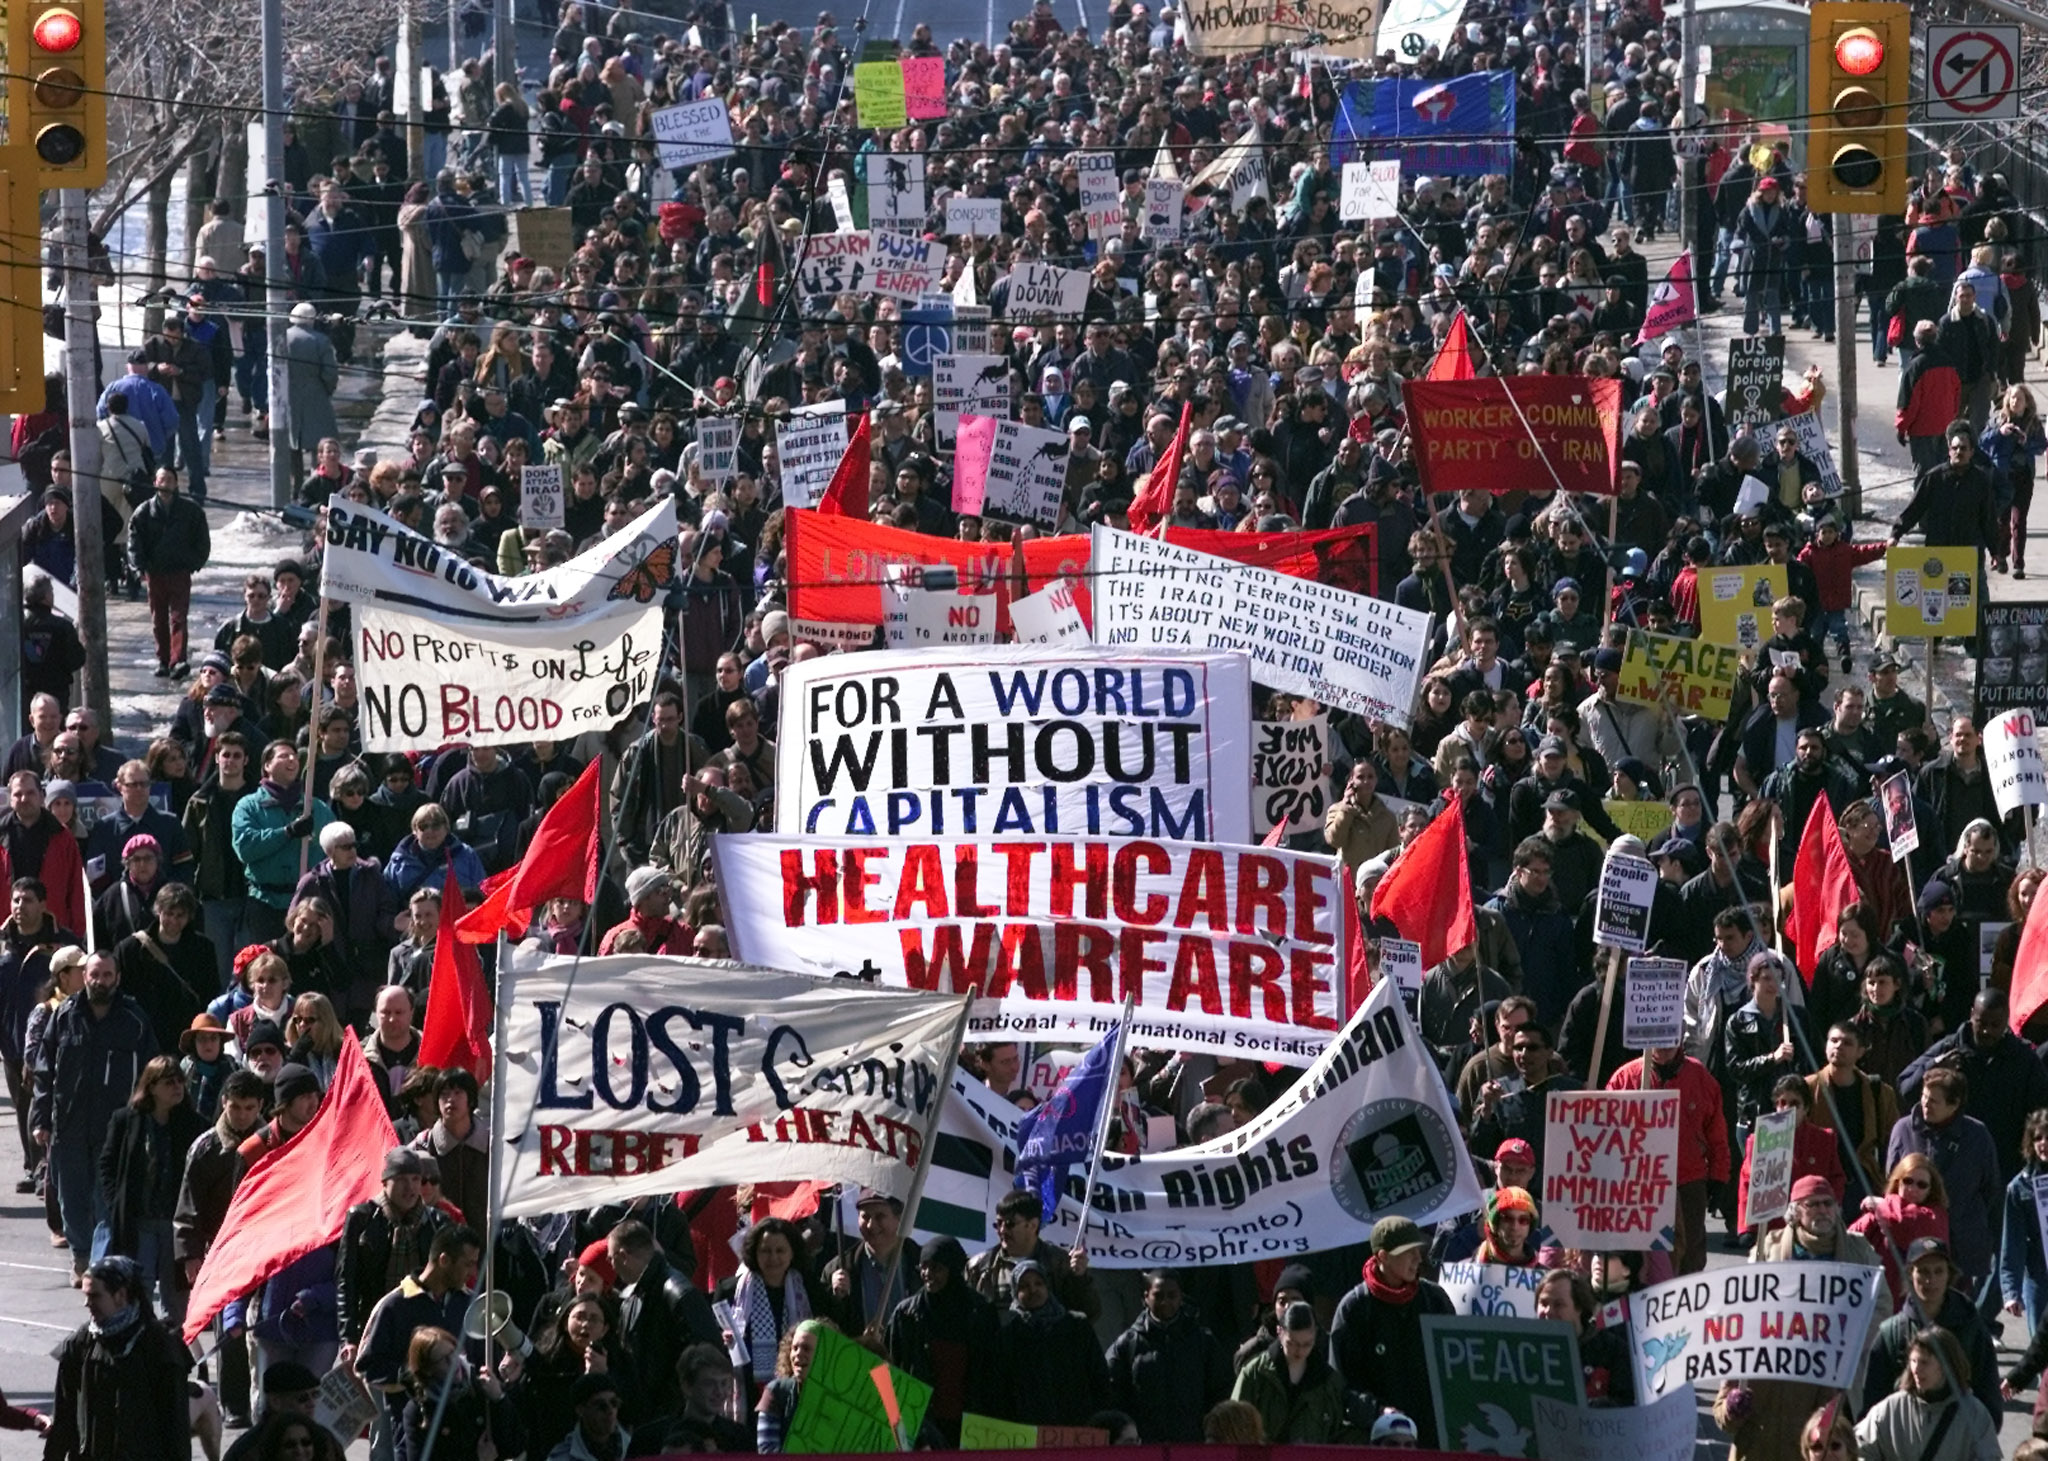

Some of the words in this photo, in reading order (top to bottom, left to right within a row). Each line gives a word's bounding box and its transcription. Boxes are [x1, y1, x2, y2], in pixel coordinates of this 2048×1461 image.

[1317, 3, 1372, 35] BOMB?
[654, 105, 721, 133] BLESSED
[1080, 155, 1115, 171] FOOD
[1088, 177, 1107, 186] NOT
[1231, 158, 1266, 191] YOUTH
[1351, 170, 1368, 183] NO
[1149, 182, 1183, 191] BOOKS
[1081, 190, 1117, 206] BOMBS
[948, 207, 1000, 227] CONSUME
[1150, 204, 1169, 213] NOT
[1345, 201, 1367, 218] OIL
[877, 233, 931, 264] BUSH
[817, 256, 846, 268] THE
[871, 258, 884, 267] IS
[887, 260, 908, 270] THE
[875, 269, 933, 296] ENEMY
[1028, 266, 1068, 290] LAY
[1016, 285, 1064, 306] DOWN
[937, 359, 956, 369] THIS
[1731, 352, 1780, 371] foreign
[937, 374, 945, 383] IS
[947, 374, 953, 383] A
[996, 385, 1008, 394] NO
[1423, 406, 1514, 429] WORKER
[702, 432, 714, 449] NO
[715, 429, 734, 448] WAR
[1000, 424, 1019, 437] THIS
[785, 434, 820, 450] DELAYED
[821, 434, 833, 446] BY
[833, 432, 841, 443] A
[995, 439, 1005, 450] IS
[1006, 440, 1013, 451] A
[1428, 439, 1502, 460] PARTY
[1518, 439, 1547, 459] OF
[1562, 438, 1604, 462] IRAN
[703, 451, 714, 470] ON
[783, 454, 811, 469] MONTH
[812, 454, 823, 466] IS
[1052, 463, 1065, 474] NO
[525, 468, 559, 478] DON'T
[525, 477, 560, 485] ATTACK
[794, 473, 806, 485] AN
[525, 484, 560, 495] IRAQ
[1042, 491, 1060, 504] FOR
[327, 507, 390, 557] SAY
[392, 531, 443, 577] NO
[900, 567, 924, 588] NO
[1111, 531, 1151, 556] THE
[1156, 546, 1200, 566] WAR
[1208, 558, 1232, 574] IS
[1239, 567, 1283, 587] NOT
[1291, 581, 1363, 607] ABOUT
[1367, 602, 1414, 632] OIL.
[1049, 586, 1075, 613] NO
[1111, 556, 1224, 590] FIGHTING
[1232, 579, 1360, 628] TERRORISM
[1366, 619, 1393, 642] OR
[947, 605, 980, 628] NO
[1108, 579, 1146, 599] THE
[1159, 586, 1225, 609] IRAQI
[1233, 599, 1322, 635] PEOPL'S
[1324, 625, 1417, 672] LIBERATION
[1983, 608, 2009, 625] WAR
[916, 628, 930, 641] TO
[1057, 621, 1081, 638] WAR
[1107, 625, 1140, 646] AND
[1151, 626, 1193, 646] USA
[1109, 602, 1145, 621] IT'S
[1149, 605, 1215, 628] ABOUT
[1218, 617, 1259, 638] NEW
[1263, 624, 1327, 656] WORLD
[1332, 646, 1393, 683] ORDER
[362, 627, 406, 663] NO
[412, 634, 511, 671] PROFIT$
[532, 658, 566, 681] ON
[570, 632, 658, 682] Life
[1626, 629, 1738, 682] PEACE
[1660, 671, 1689, 683] NOT
[1308, 678, 1350, 699] WORKER
[1638, 676, 1707, 711] WAR
[1980, 686, 2003, 702] PUT
[2006, 686, 2035, 702] THEM
[365, 683, 428, 738] NO
[440, 683, 563, 738] BLOOD
[571, 704, 602, 722] FOR
[811, 675, 902, 736] FOR
[924, 671, 966, 721] A
[987, 667, 1196, 719] WORLD
[2003, 713, 2034, 740] NO
[808, 718, 1202, 798] WITHOUT
[1603, 875, 1622, 889] Not
[1605, 863, 1650, 883] People
[779, 841, 1335, 948] HEALTHCARE
[1601, 886, 1631, 902] Profit
[1603, 900, 1641, 916] Homes
[1611, 911, 1630, 925] Not
[1601, 920, 1638, 938] Bombs
[1381, 948, 1417, 965] People
[898, 921, 1338, 1032] WARFARE
[1632, 981, 1662, 992] Don't
[1665, 981, 1680, 991] let
[1635, 1004, 1659, 1013] take
[1636, 1016, 1648, 1025] to
[1650, 1016, 1671, 1025] war
[533, 1000, 746, 1118] LOST
[1549, 1097, 1679, 1129] IMPERIALIST
[1569, 1123, 1647, 1156] WAR
[1160, 1133, 1319, 1212] Rights
[1565, 1150, 1594, 1174] IS
[1620, 1153, 1670, 1187] THE
[1373, 1170, 1436, 1212] SPHR
[1546, 1174, 1673, 1207] IMMINENT
[1573, 1203, 1660, 1234] THREAT
[1439, 1262, 1492, 1286] WHAT
[1481, 1285, 1504, 1301] OF
[1723, 1273, 1781, 1305] OUR
[1702, 1313, 1745, 1345] NO
[1759, 1311, 1849, 1347] WAR!
[1441, 1335, 1568, 1387] PEACE
[1685, 1346, 1844, 1383] BASTARDS!
[1536, 1400, 1567, 1431] NO
[1579, 1414, 1627, 1440] MORE
